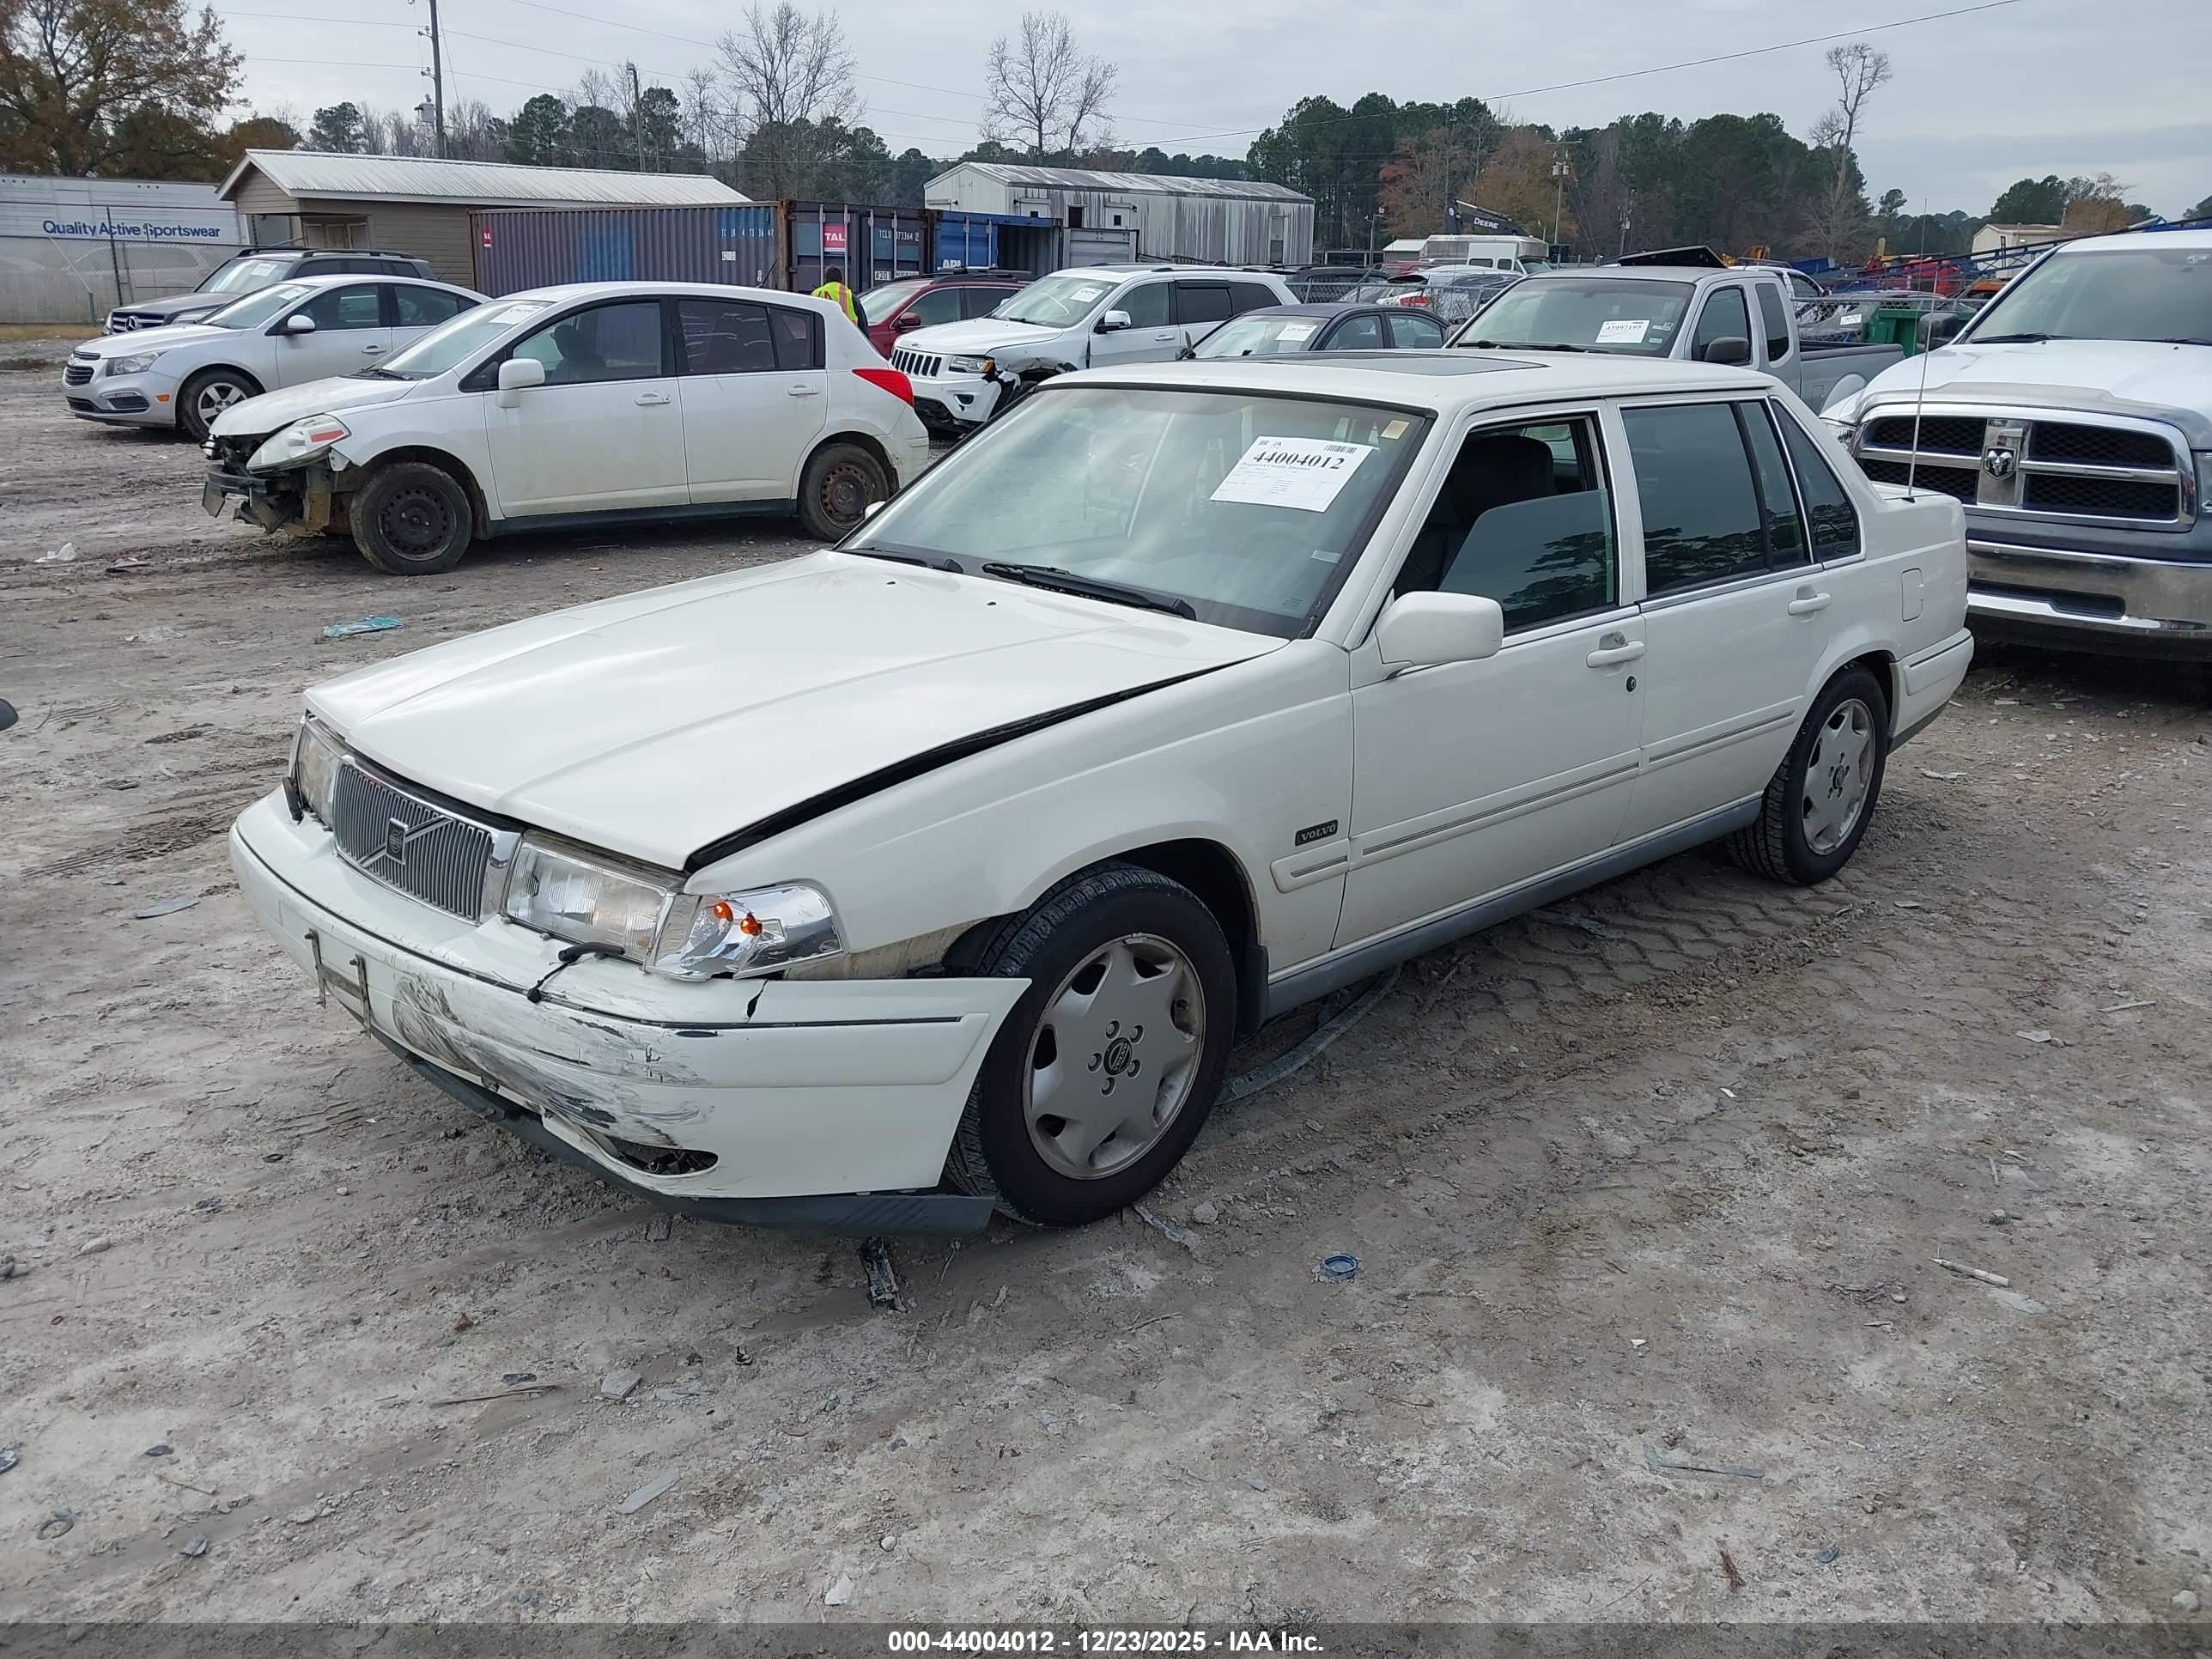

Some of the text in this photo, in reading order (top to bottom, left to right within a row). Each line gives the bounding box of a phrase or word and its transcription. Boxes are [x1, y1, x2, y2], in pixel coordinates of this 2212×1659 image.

[43, 220, 97, 237] Quality
[99, 222, 141, 236] Active
[1474, 217, 1499, 229] DEERE
[824, 233, 845, 241] TAL
[1253, 451, 1346, 470] 44004012
[1301, 823, 1336, 841] VOLVO
